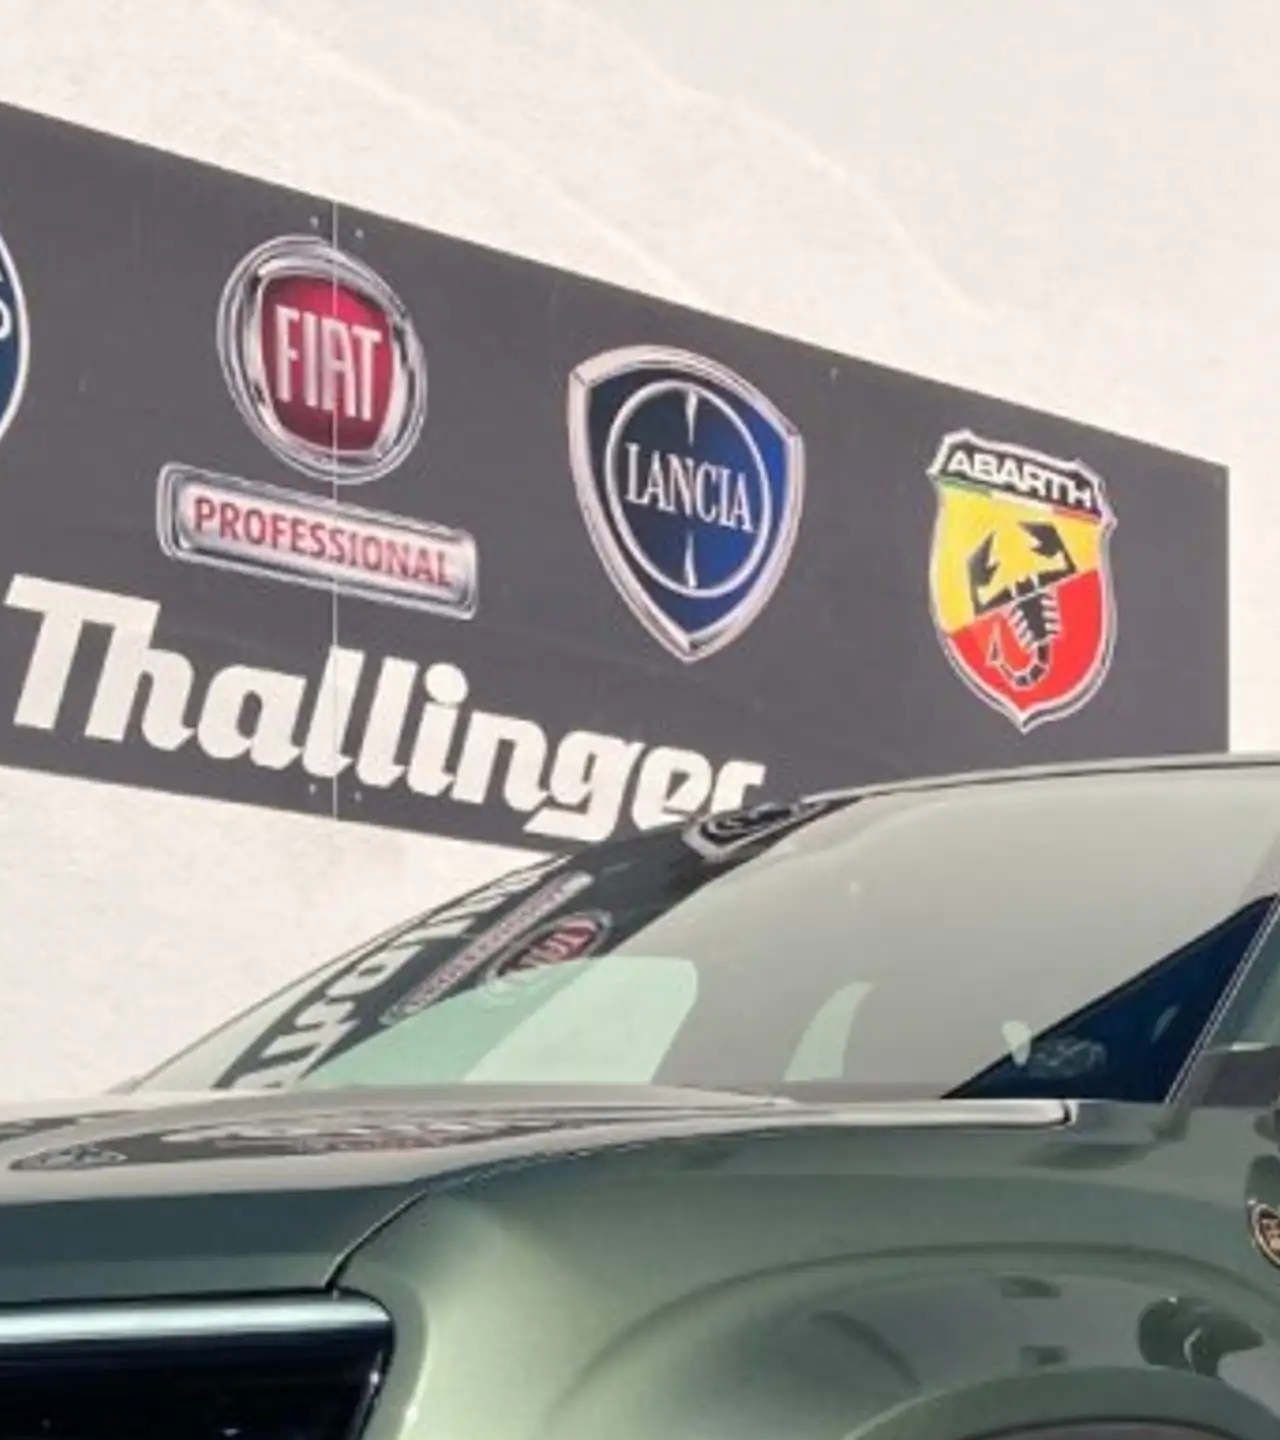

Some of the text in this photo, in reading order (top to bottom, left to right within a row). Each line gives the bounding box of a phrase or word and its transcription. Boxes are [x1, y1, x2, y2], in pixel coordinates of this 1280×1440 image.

[274, 304, 382, 421] FIAT
[624, 441, 754, 533] LANCIA
[946, 450, 1092, 508] ABARTH
[193, 494, 452, 587] PROFESSIONAL
